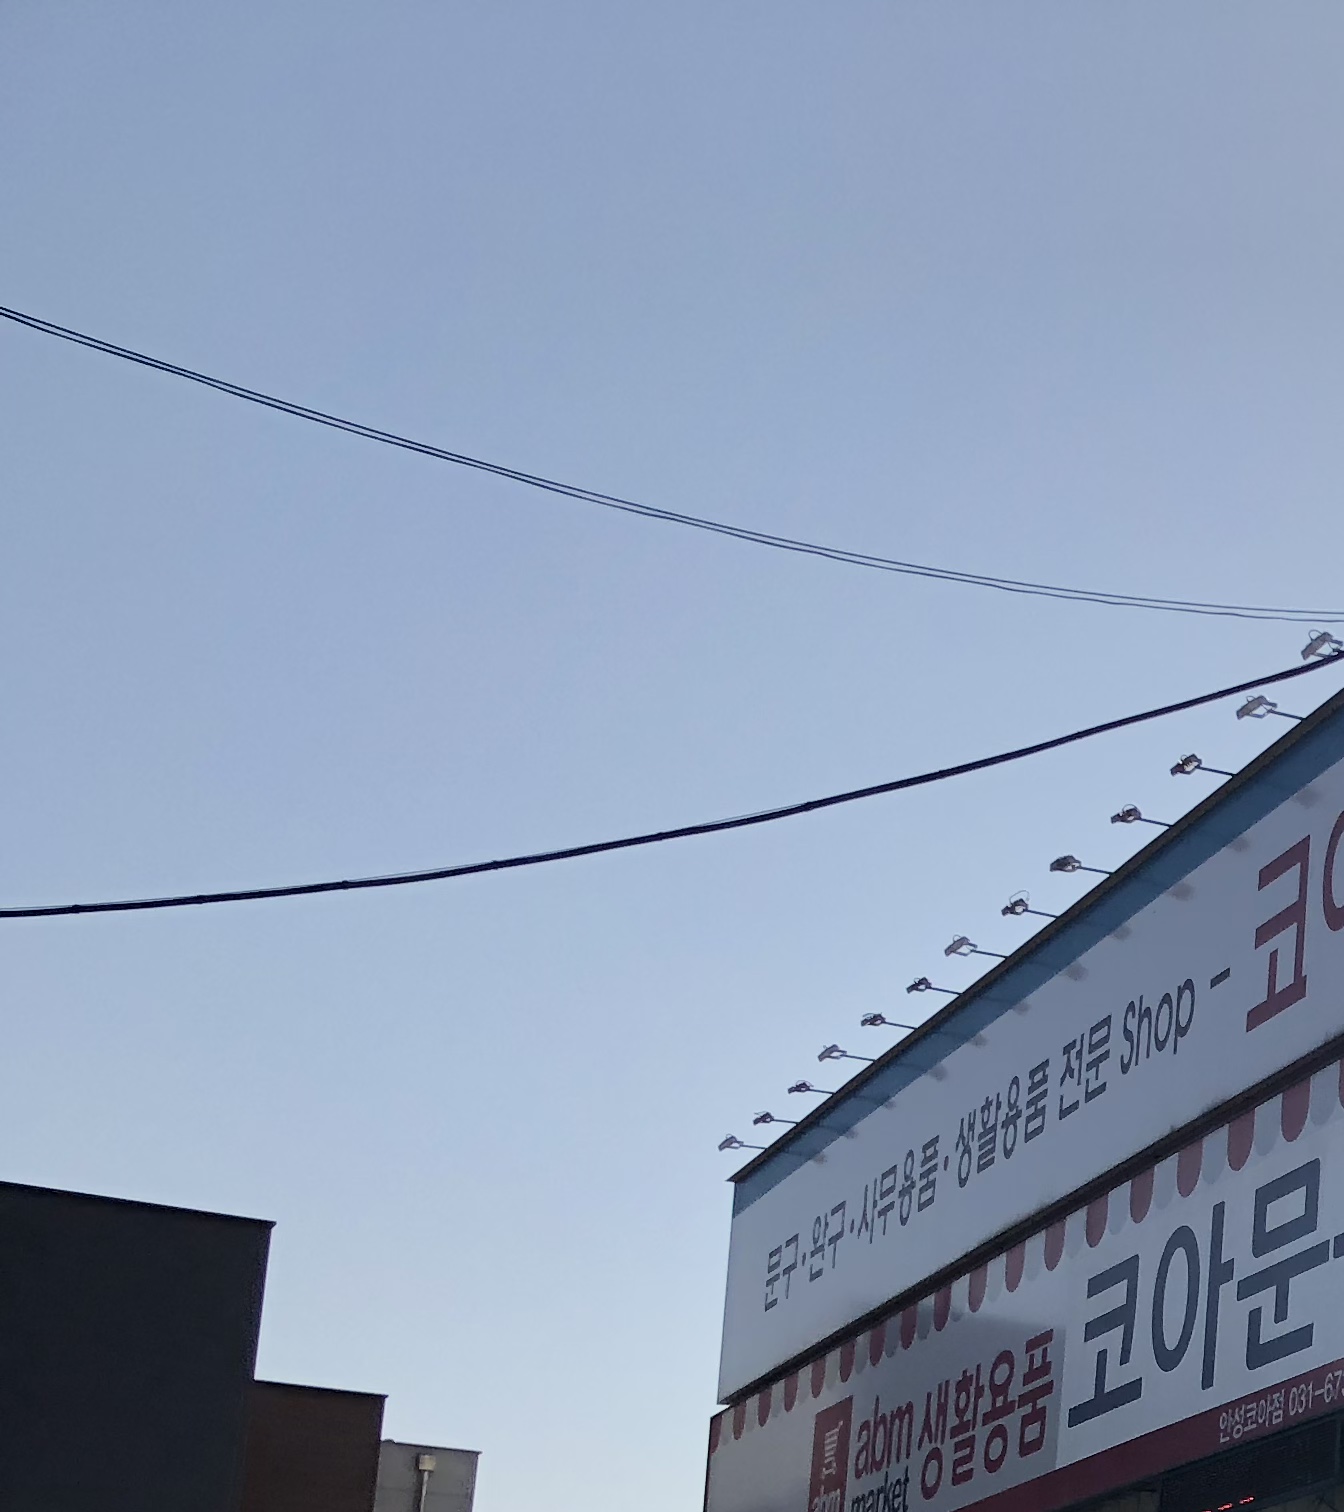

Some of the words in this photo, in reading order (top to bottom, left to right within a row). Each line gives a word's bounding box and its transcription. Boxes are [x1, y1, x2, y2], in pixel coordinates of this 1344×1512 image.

[1058, 1014, 1112, 1121] 전문
[1119, 977, 1195, 1075] Shop
[854, 1393, 914, 1478] abm
[917, 1327, 1057, 1501] 생활용품
[1219, 1389, 1286, 1444] 안성코아점
